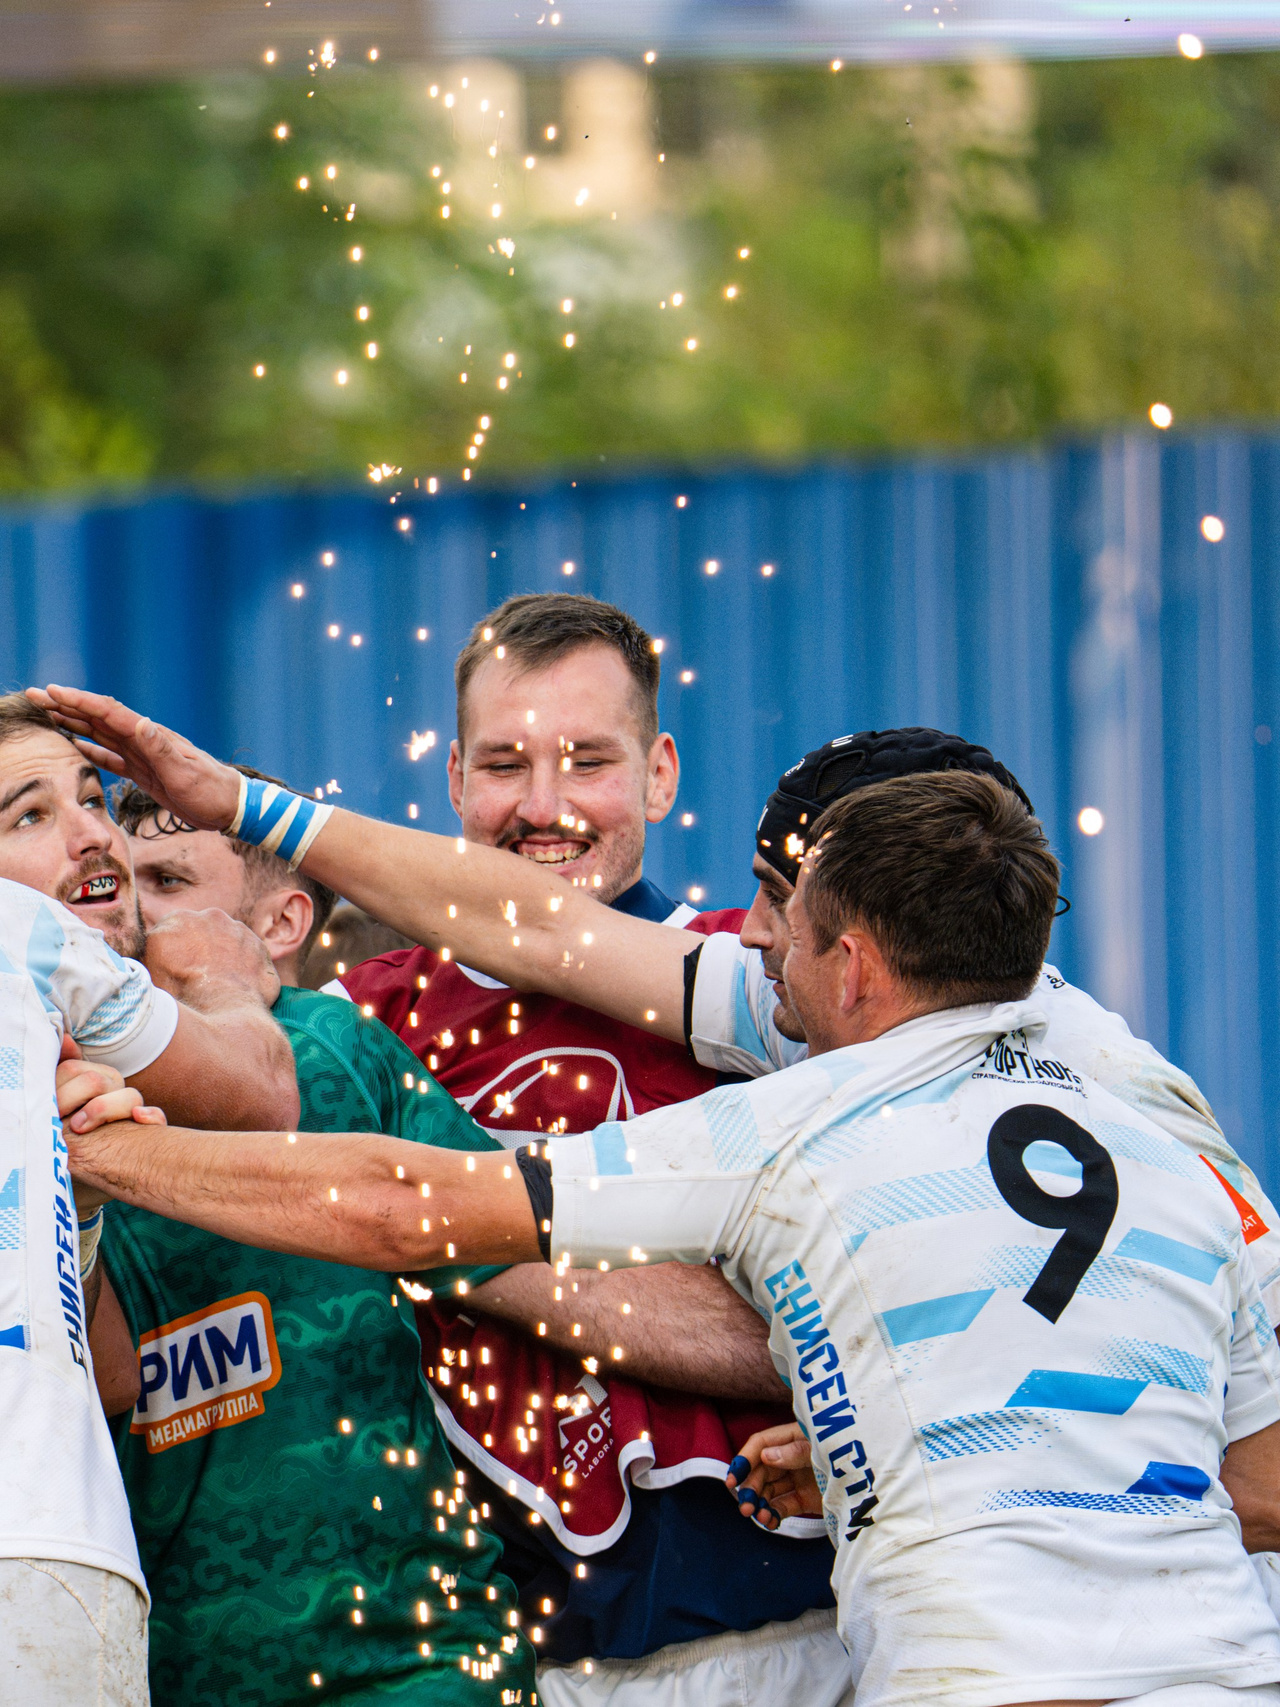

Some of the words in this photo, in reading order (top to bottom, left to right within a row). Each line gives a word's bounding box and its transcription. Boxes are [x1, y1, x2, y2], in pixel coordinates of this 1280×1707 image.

[987, 1103, 1119, 1325] 9
[149, 1392, 259, 1447] МЕДИАГРУППА
[764, 1258, 857, 1443] ЕНИСЕЙ
